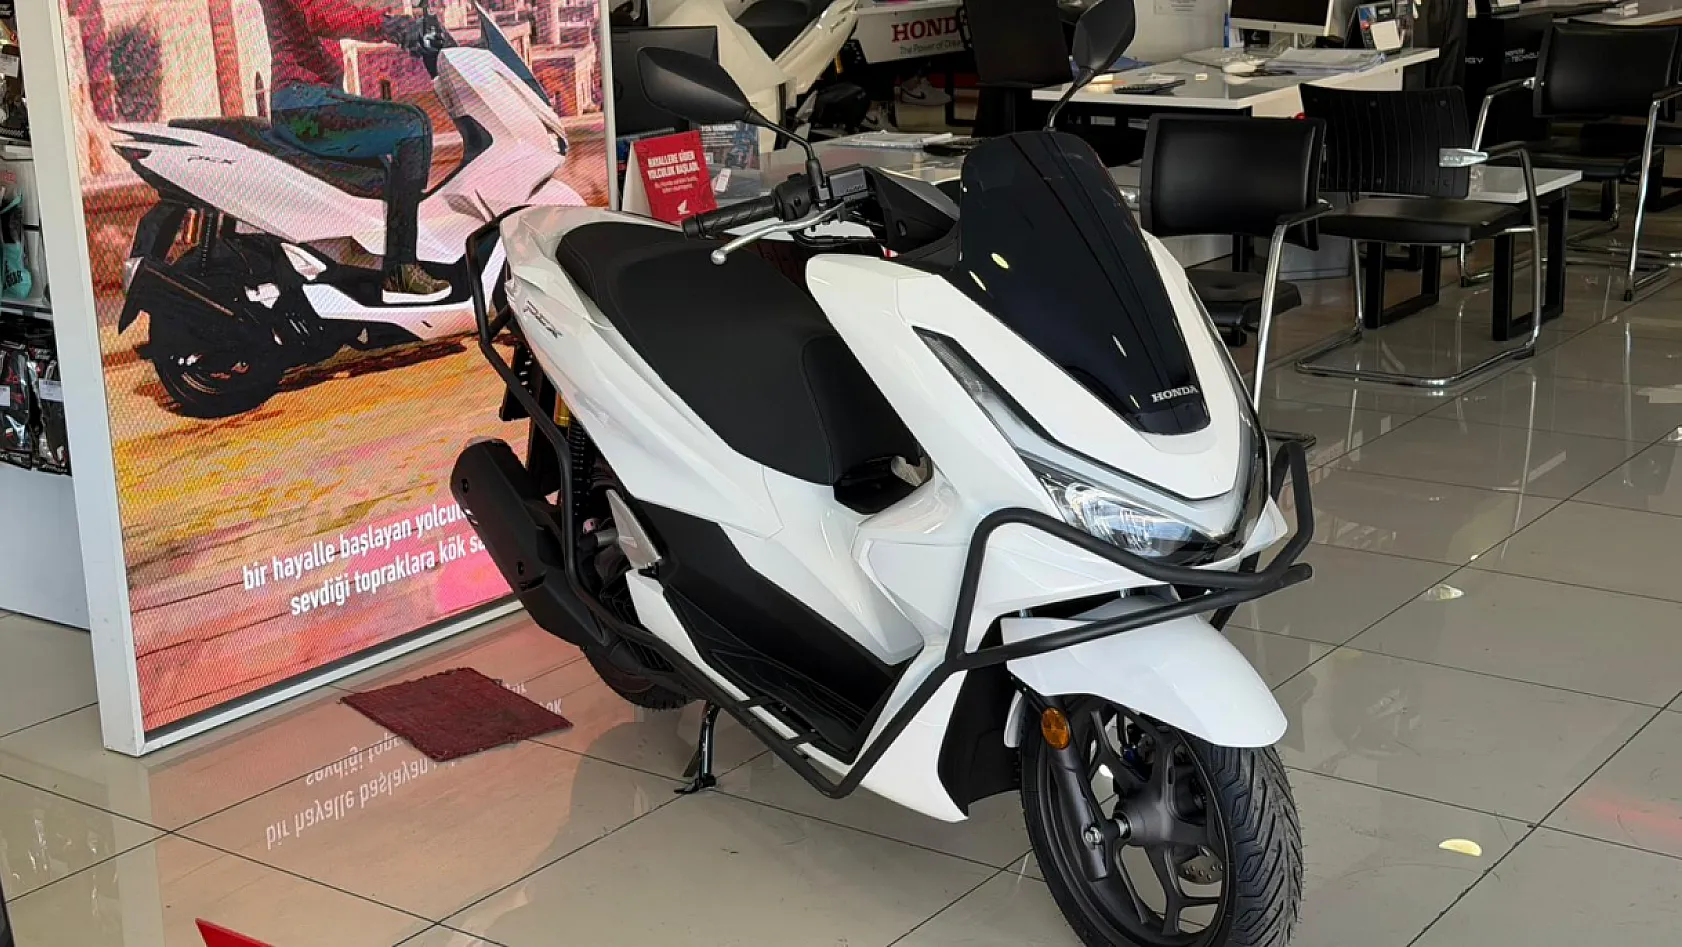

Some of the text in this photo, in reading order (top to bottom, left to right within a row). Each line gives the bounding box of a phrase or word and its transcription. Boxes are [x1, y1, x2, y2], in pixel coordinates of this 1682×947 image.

[891, 16, 960, 43] HOND
[523, 300, 563, 338] PCX
[1151, 385, 1199, 403] HONDA
[243, 561, 268, 590] bir
[272, 540, 336, 581] hayalle
[339, 518, 412, 558] başlayan
[290, 573, 351, 616] sevdiği
[354, 550, 436, 594] topraklara
[438, 535, 466, 563] kök
